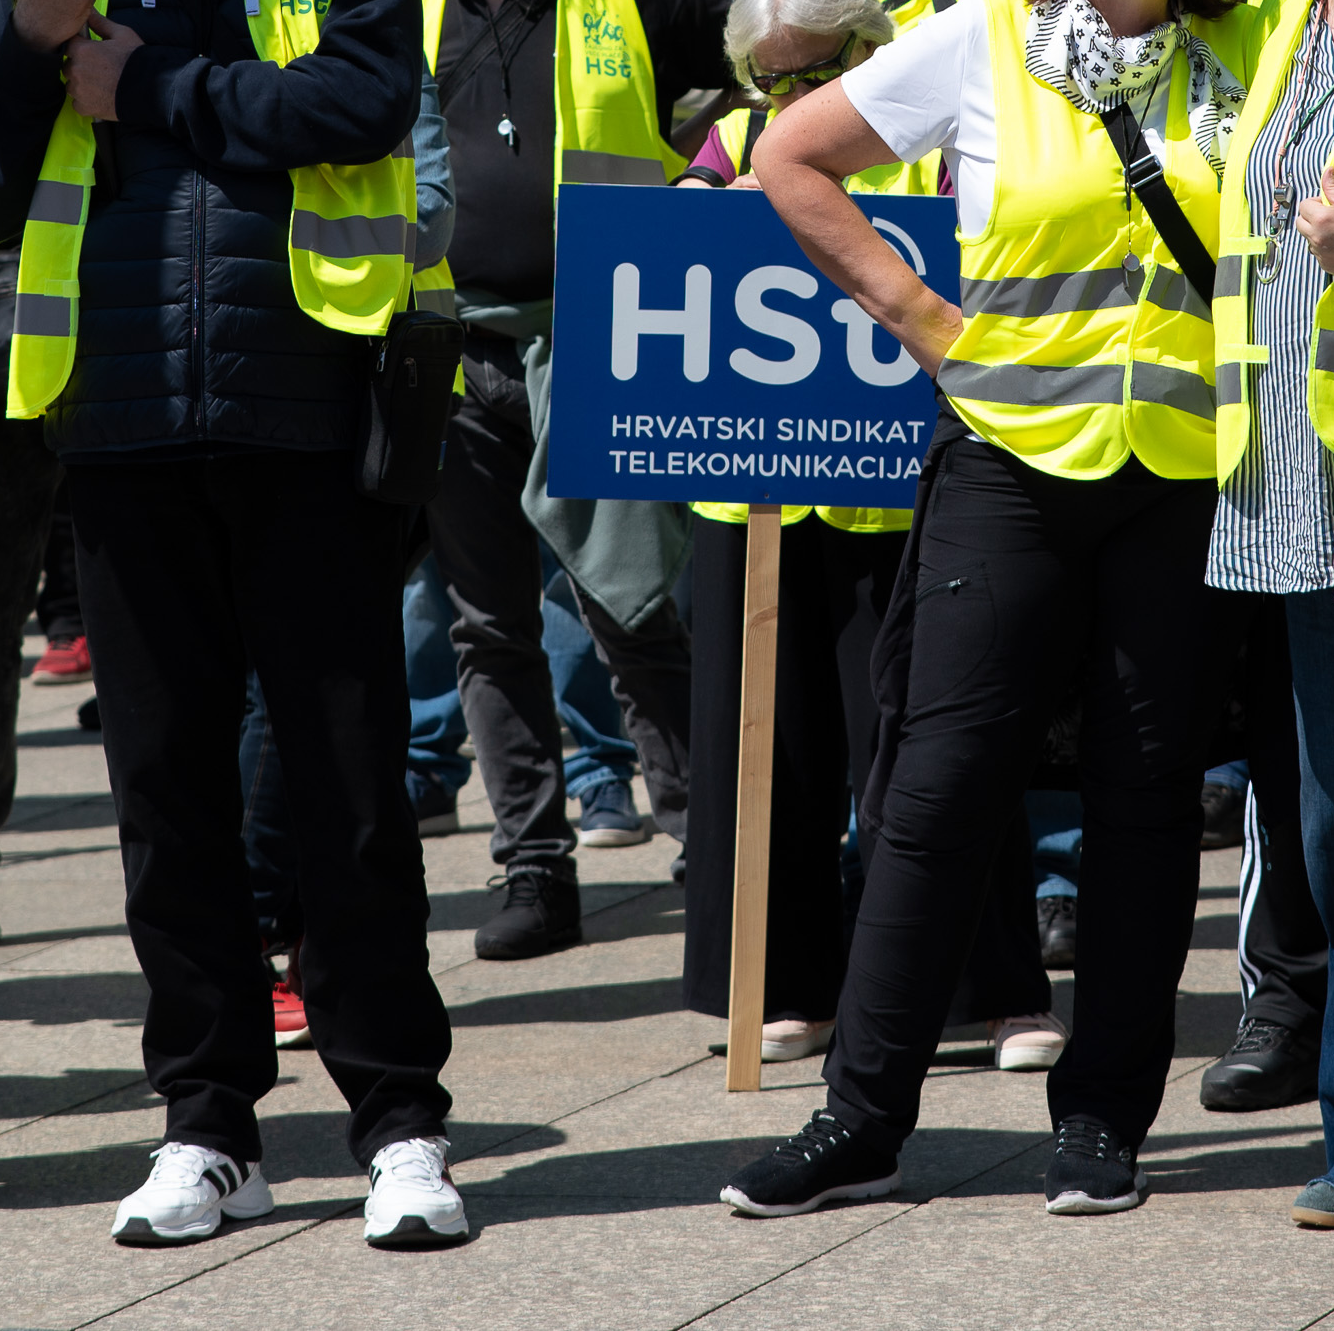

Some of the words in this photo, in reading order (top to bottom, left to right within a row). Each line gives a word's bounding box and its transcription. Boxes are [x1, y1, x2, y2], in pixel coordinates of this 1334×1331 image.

[611, 414, 765, 441] HRVATSKI
[777, 417, 926, 445] SINDIKAT
[608, 450, 923, 480] TELEKOMUNIKACIJA
